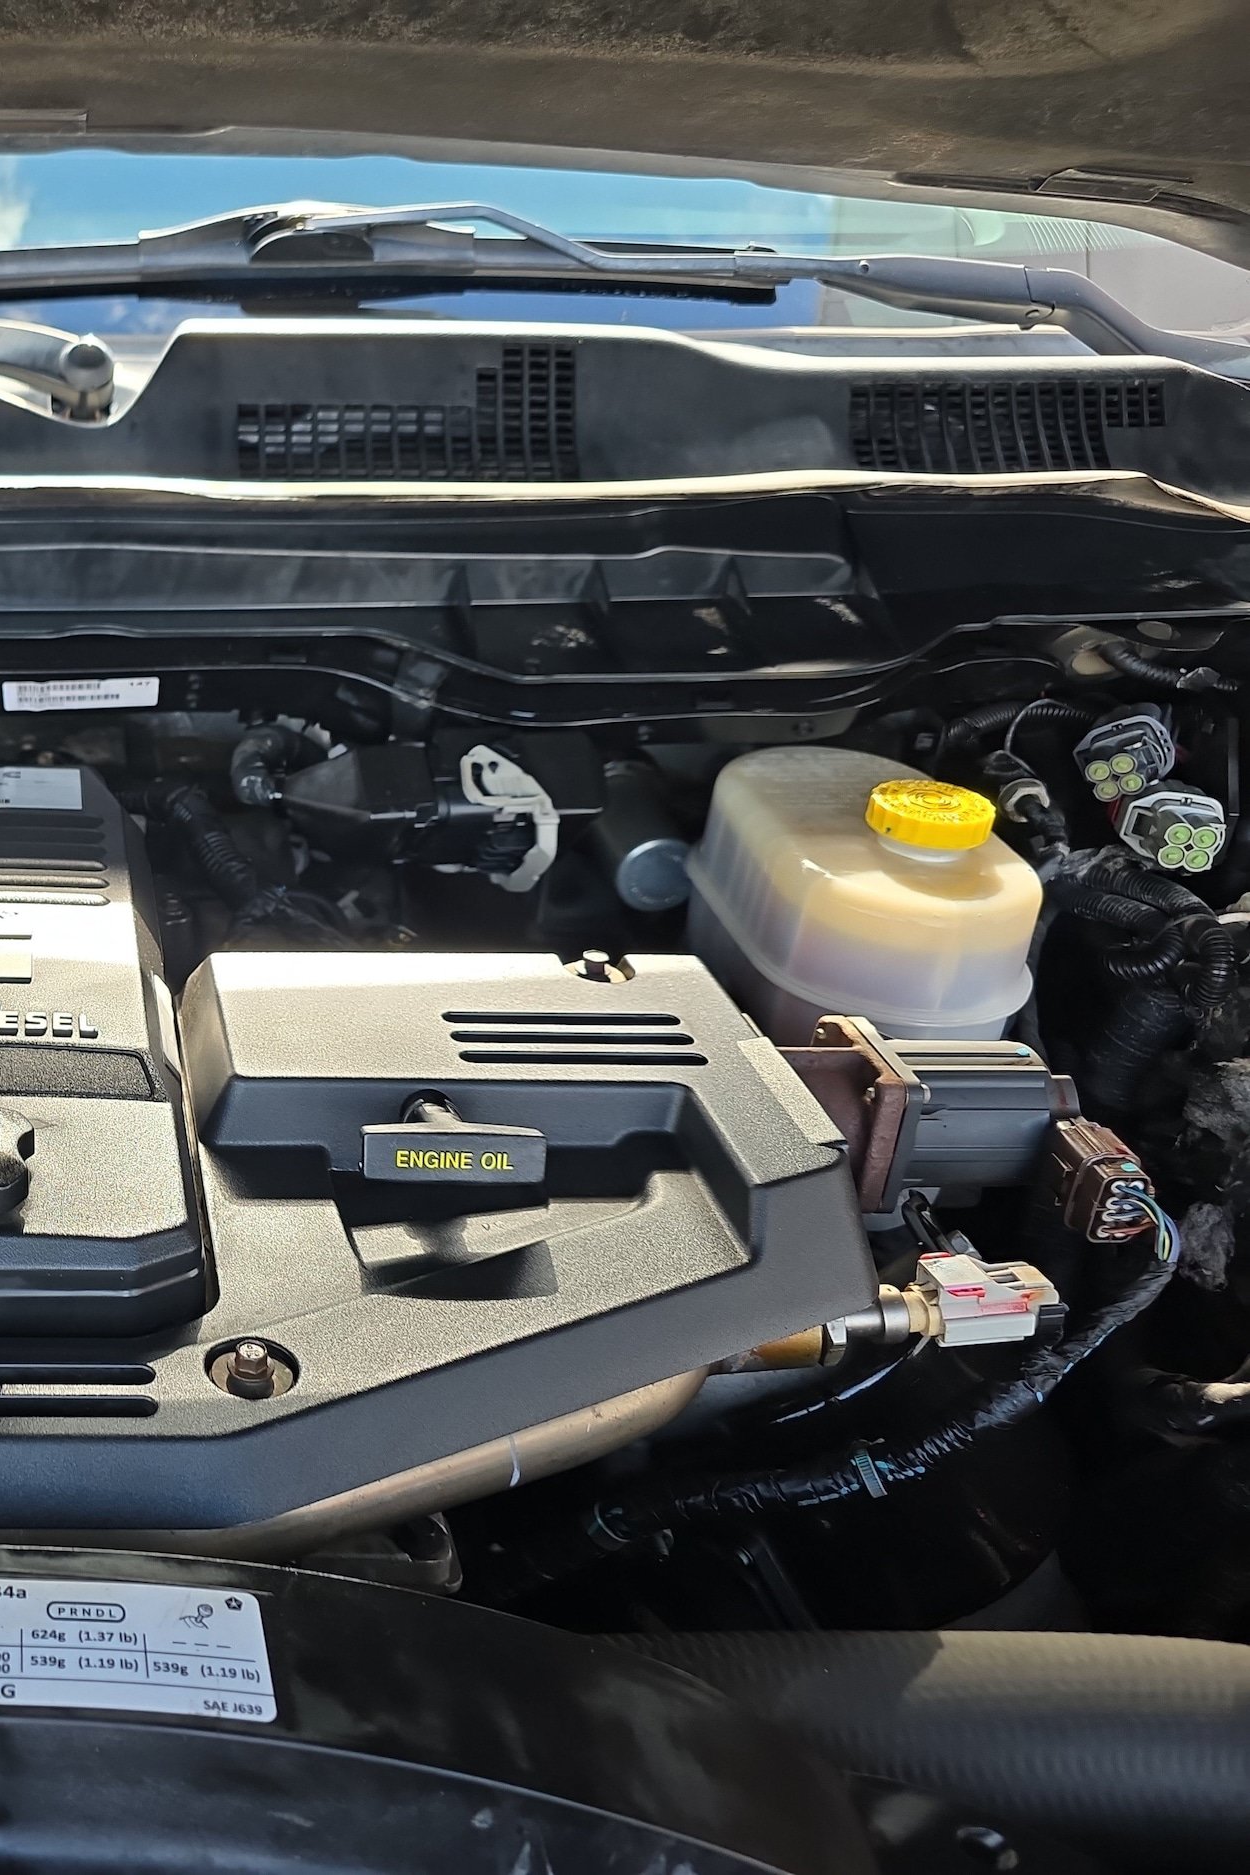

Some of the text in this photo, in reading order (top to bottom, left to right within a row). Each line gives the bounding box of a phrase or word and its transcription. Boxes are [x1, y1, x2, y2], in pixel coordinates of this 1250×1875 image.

[396, 1150, 514, 1171] ENGINE OIL
[31, 1630, 66, 1643] 624g
[78, 1630, 114, 1644] (1.37
[119, 1631, 138, 1646] lb)
[30, 1655, 261, 1683] 539g (1.19 lb) 539g (1.19 lb)
[203, 1700, 263, 1716] SAE J639
